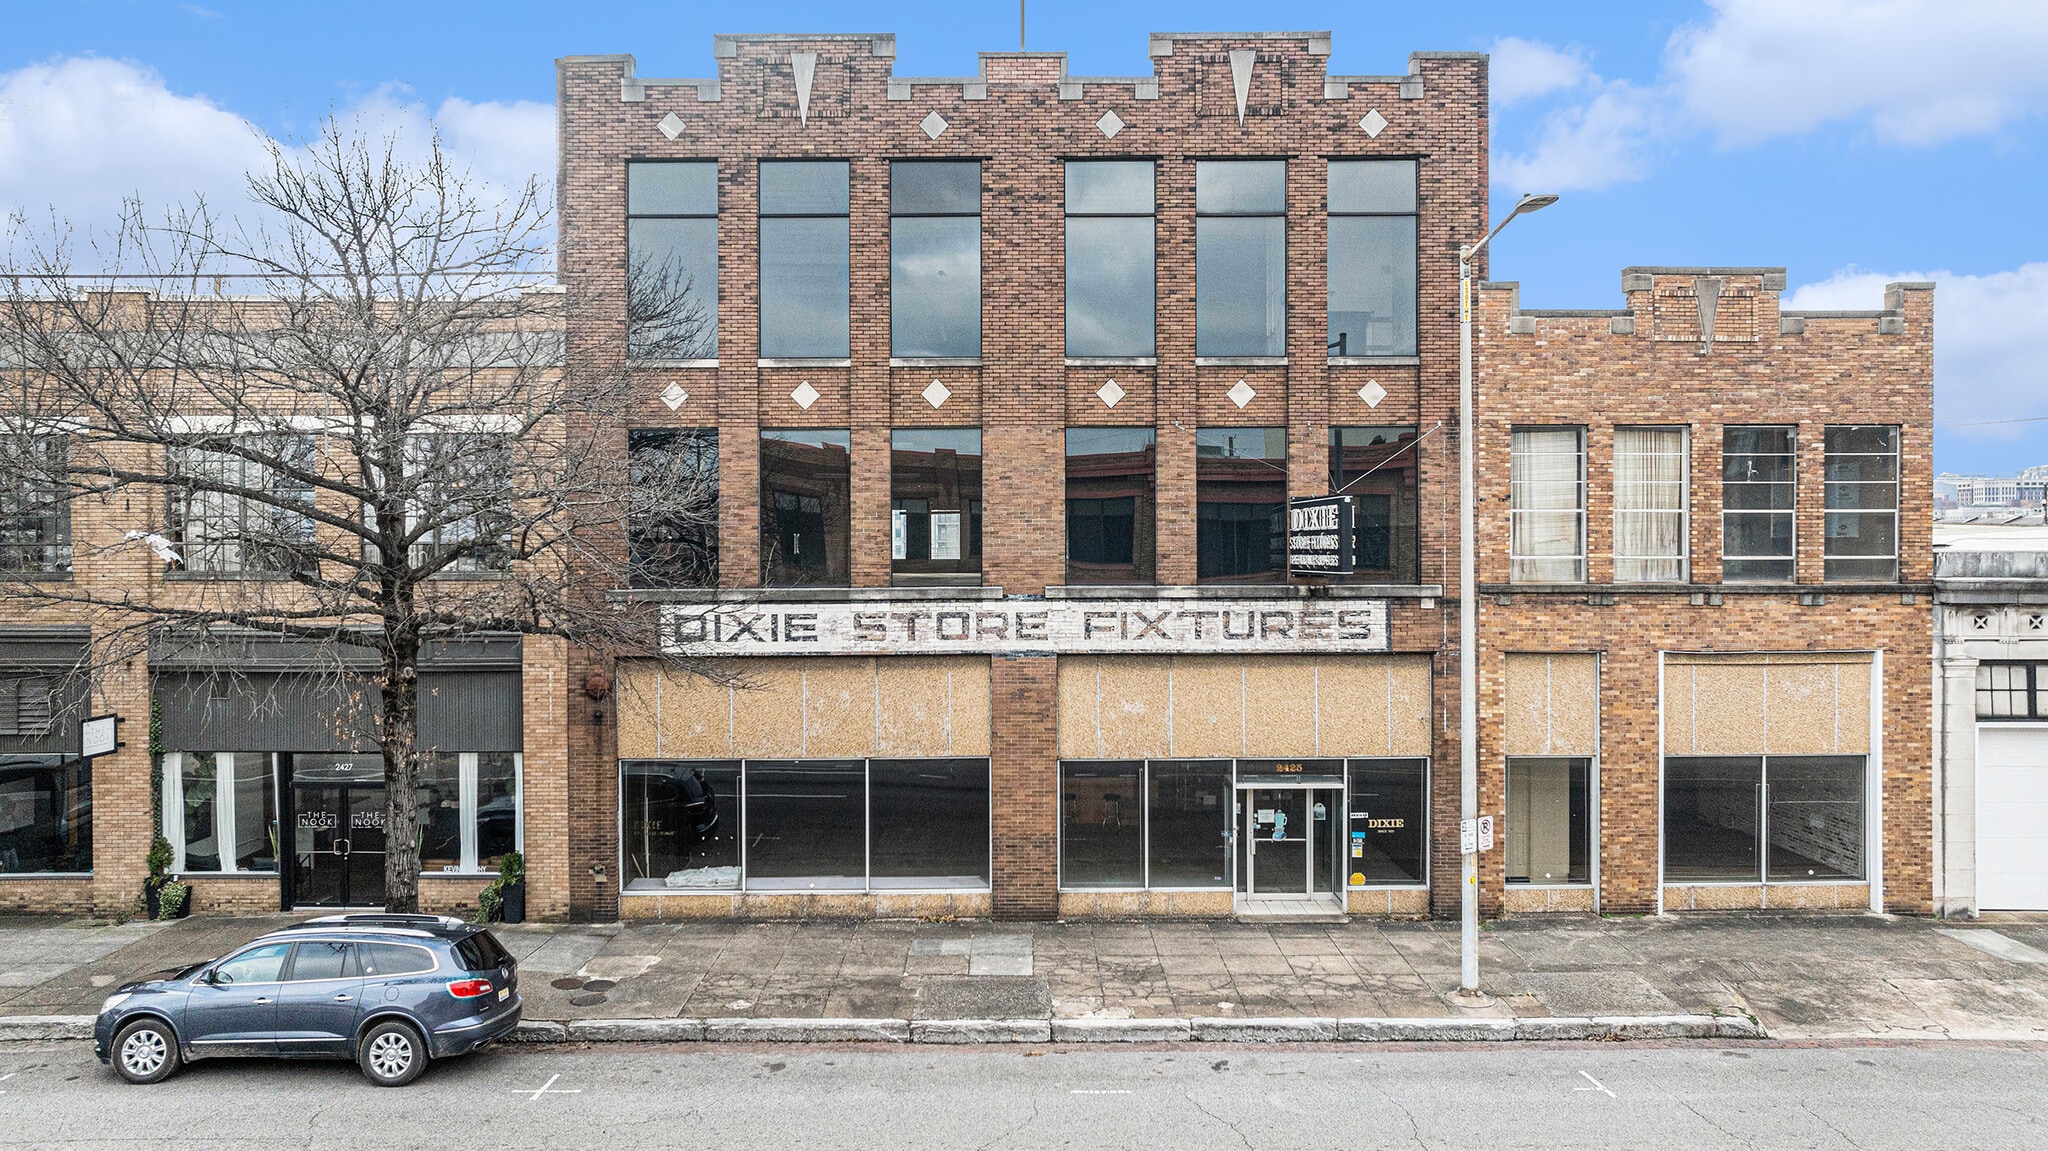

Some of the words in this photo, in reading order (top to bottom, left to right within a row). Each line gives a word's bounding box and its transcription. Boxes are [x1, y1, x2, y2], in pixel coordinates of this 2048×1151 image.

[1290, 504, 1339, 531] DIXIE
[674, 613, 818, 642] DIXIE
[853, 612, 1048, 642] STORE
[1083, 610, 1371, 640] FIXTURES
[334, 763, 353, 771] 2427
[1276, 764, 1303, 772] 2425
[307, 811, 327, 819] THE
[361, 811, 380, 819] THE
[301, 818, 333, 826] NOOK
[1368, 819, 1404, 828] DIXIE
